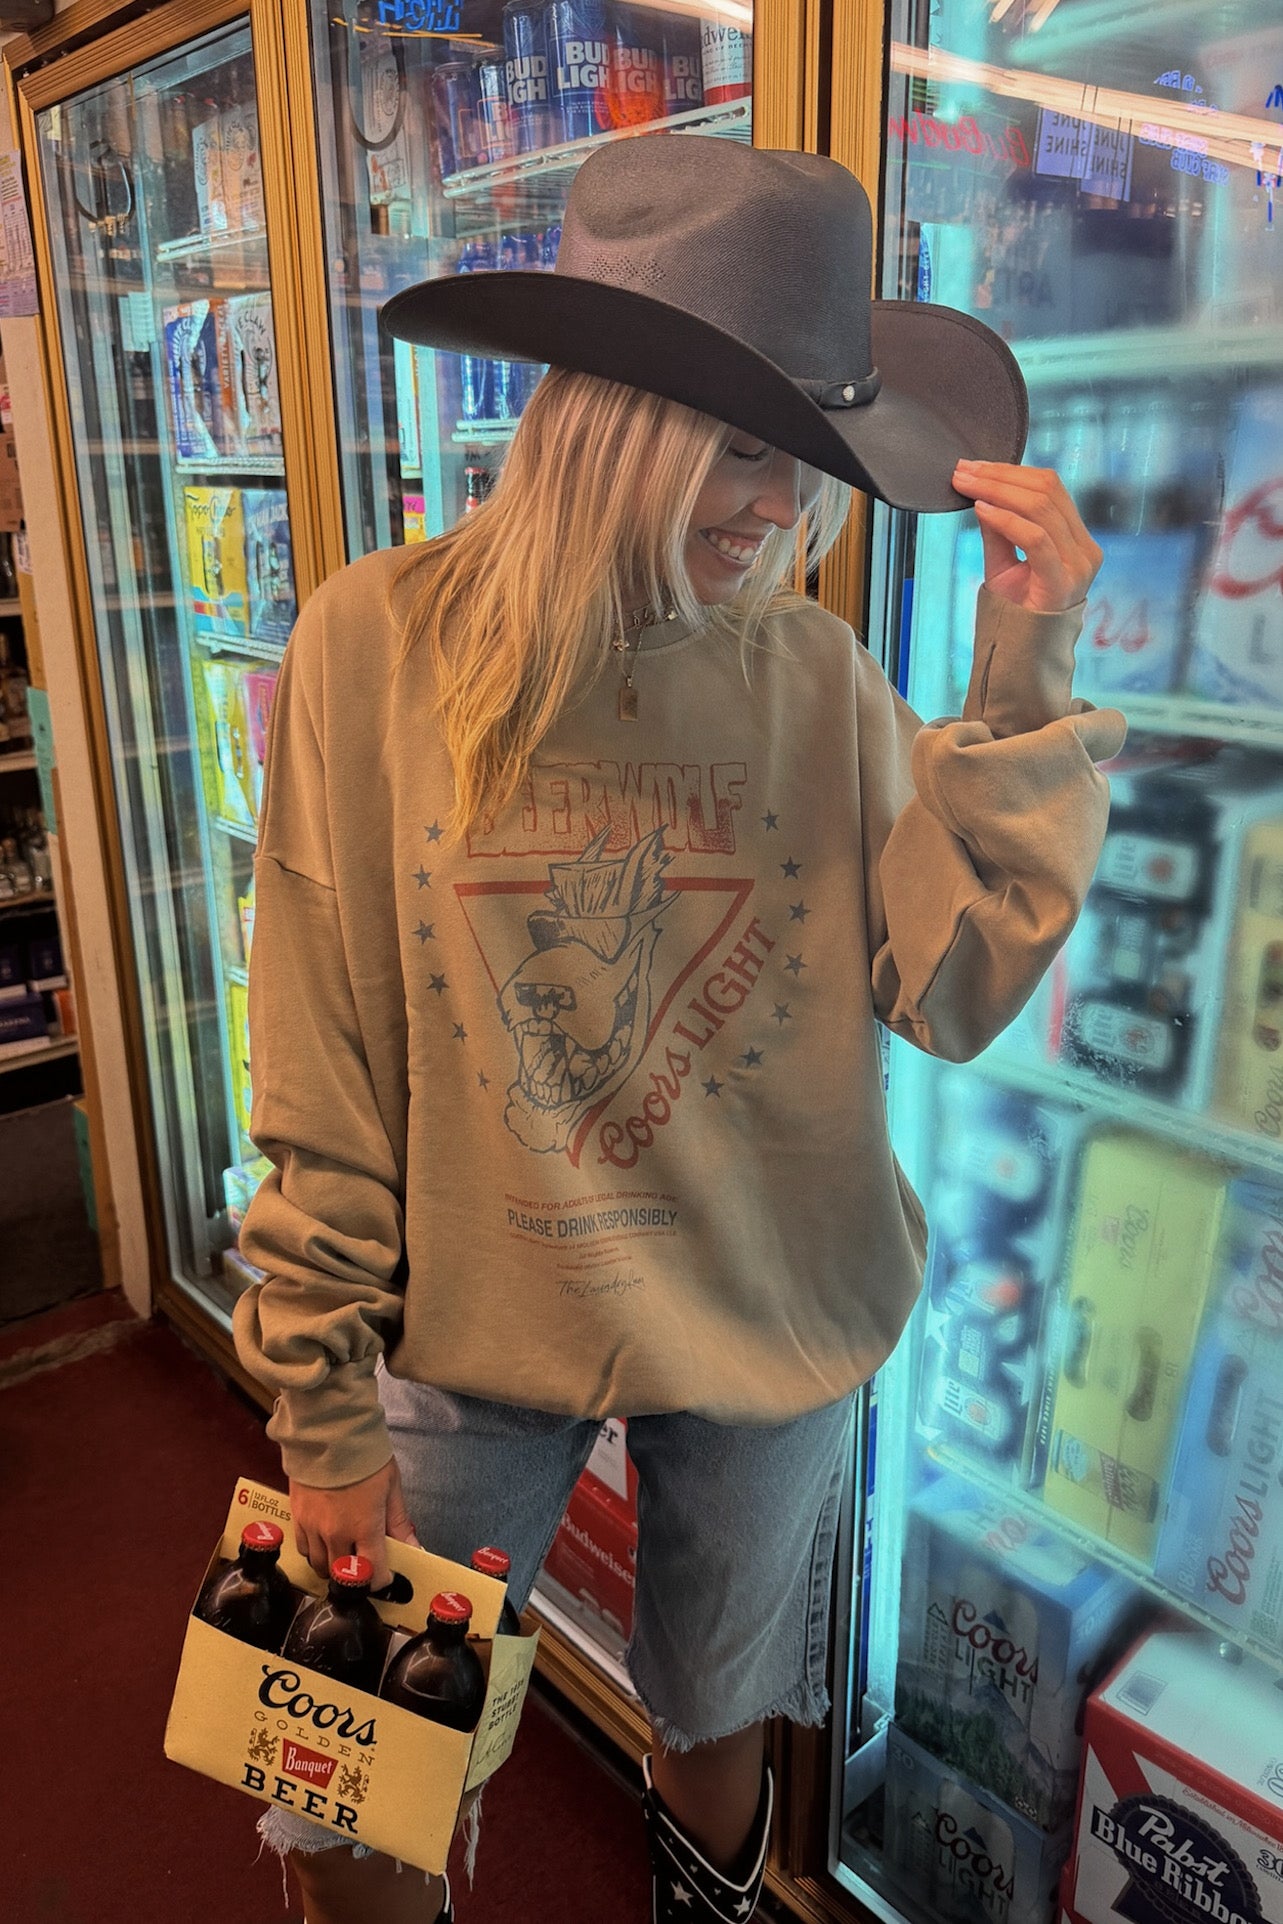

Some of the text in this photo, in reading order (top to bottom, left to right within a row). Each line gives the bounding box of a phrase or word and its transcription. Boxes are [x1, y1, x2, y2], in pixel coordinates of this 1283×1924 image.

[506, 56, 546, 80] BUD
[466, 760, 748, 859] EERWOLF
[596, 916, 776, 1170] Coors LIGHT
[507, 1207, 678, 1239] PLEASE DRINK RESPONSIBLY
[541, 1201, 561, 1211] FOR
[615, 1190, 658, 1200] DRINKING
[237, 1488, 250, 1506] 6
[251, 1499, 292, 1522] BOTTLES
[1206, 1494, 1264, 1606] Coors
[950, 1597, 1040, 1686] Coors
[954, 1637, 1032, 1704] LIGHT
[258, 1664, 378, 1746] Coors
[488, 1702, 518, 1731] BOTTLE
[491, 1692, 520, 1718] STUBBY
[492, 1691, 508, 1707] THE
[253, 1710, 376, 1767] GOLDEN
[285, 1746, 333, 1779] Banquet
[241, 1762, 359, 1834] BEER
[931, 1804, 1015, 1902] Coors
[1095, 1809, 1252, 1924] Blue Ribbo
[1138, 1804, 1231, 1888] Pabst
